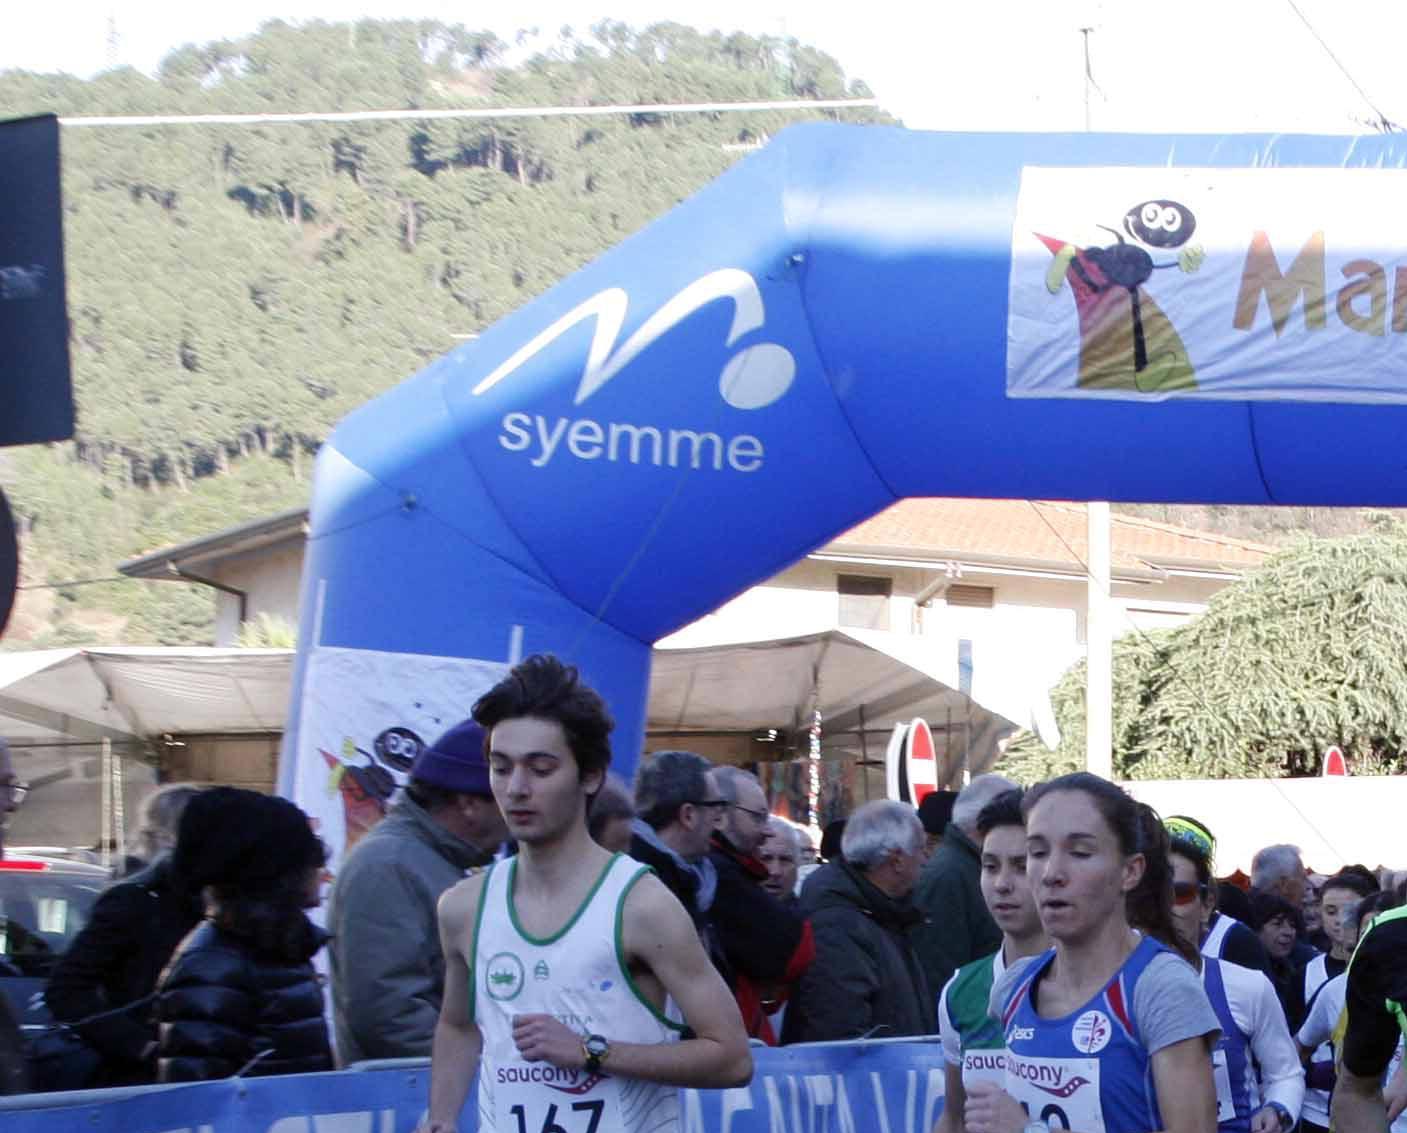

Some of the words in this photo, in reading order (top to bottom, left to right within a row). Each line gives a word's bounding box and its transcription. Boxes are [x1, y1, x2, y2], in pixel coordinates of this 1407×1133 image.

[498, 411, 765, 472] syemme
[965, 1055, 1006, 1070] sauc
[497, 1064, 580, 1085] saucony
